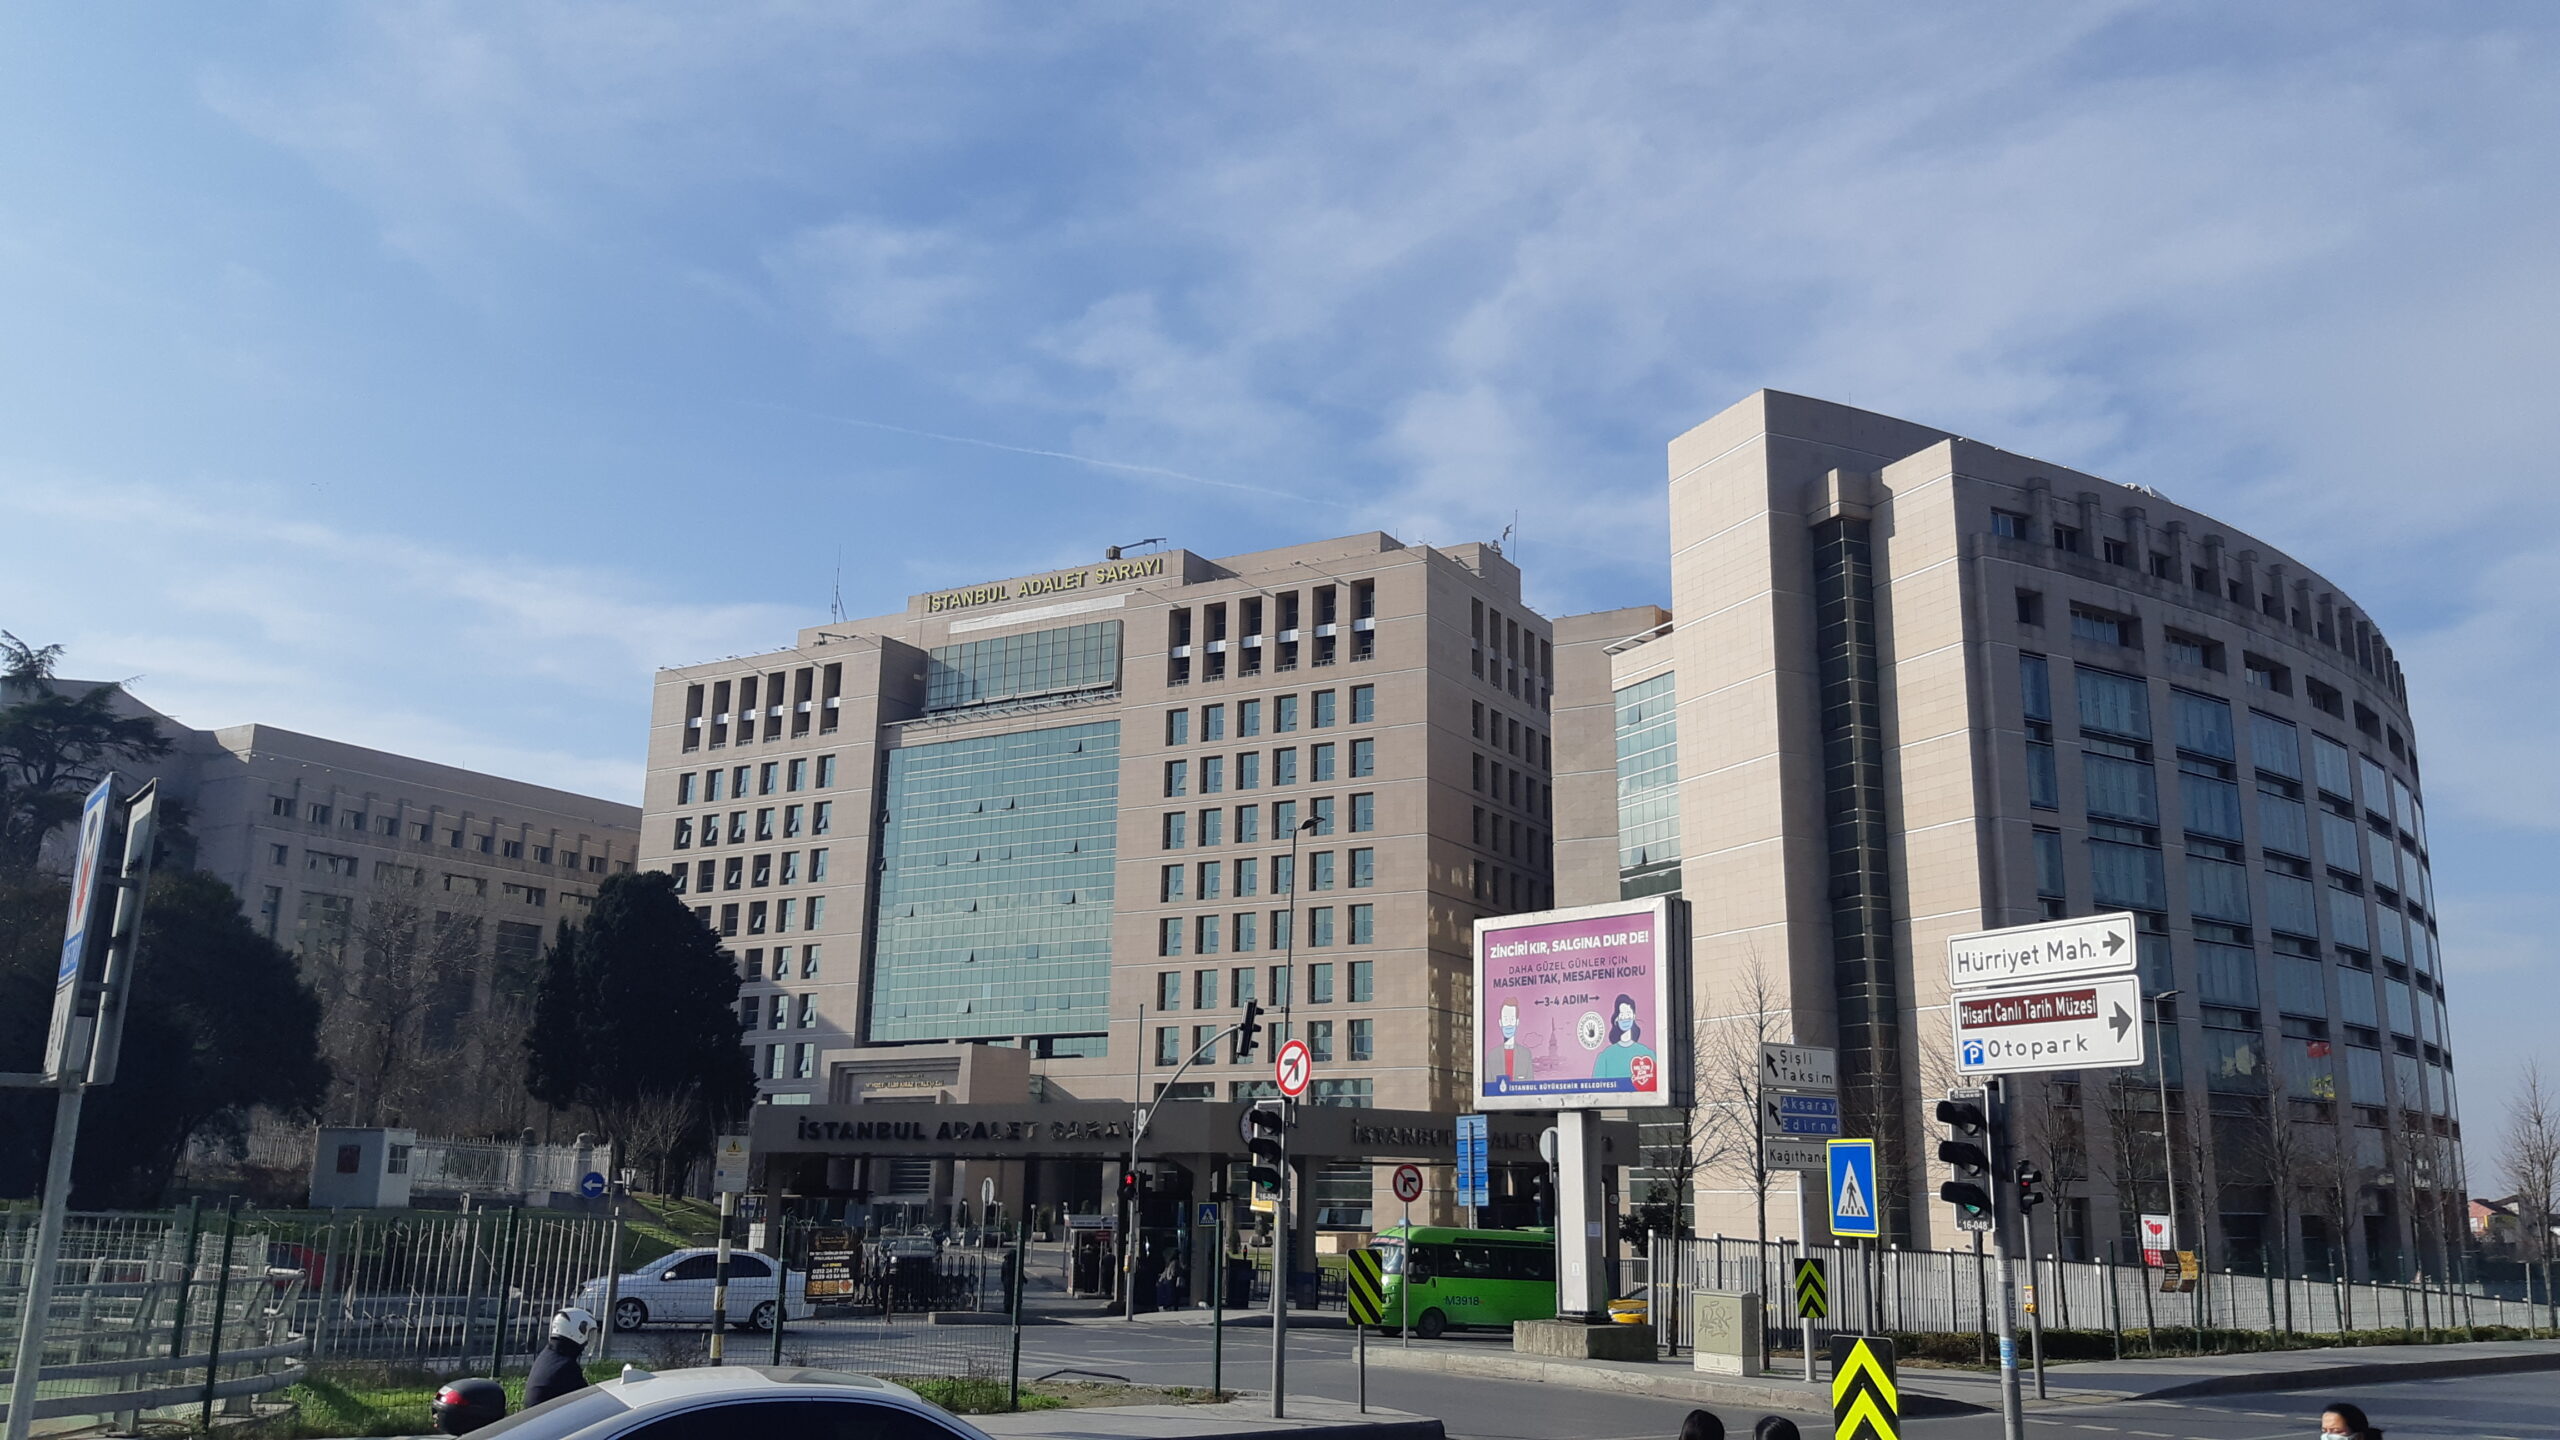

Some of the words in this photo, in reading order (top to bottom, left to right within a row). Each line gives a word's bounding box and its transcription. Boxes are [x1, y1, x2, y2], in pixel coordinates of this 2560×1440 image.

[927, 585, 1010, 613] İSTANBUL
[1017, 571, 1088, 599] ADALET
[1095, 557, 1163, 585] SARAYI
[1490, 940, 1528, 959] ZİNCİRİ
[1529, 940, 1550, 956] KIR,
[1552, 937, 1600, 952] SALGINA
[1603, 933, 1627, 947] DUR
[1629, 930, 1649, 945] DE!
[1957, 945, 2040, 973] Hürriyet
[2047, 937, 2097, 963] Mah.
[1508, 963, 1533, 975] DAHA
[1536, 960, 1566, 972] GÜZEL
[1568, 957, 1605, 970] GÜNLER
[1608, 955, 1628, 968] İÇİN
[1538, 971, 1561, 986] TAK,
[1562, 967, 1615, 983] MESAFENİ
[1616, 964, 1646, 979] KORU
[1544, 996, 1560, 1007] 3-4
[1562, 993, 1589, 1006] ADIM
[1960, 1004, 1993, 1026] Hisart
[1994, 1000, 2022, 1022] Canlı
[2023, 997, 2053, 1020] Tarih
[2055, 994, 2097, 1018] Müzesi
[1988, 1033, 2089, 1060] Otopark
[1780, 1049, 1812, 1066] Şişli
[1781, 1067, 1833, 1085] Taksim
[1782, 1097, 1836, 1113] Aksaray
[1782, 1118, 1837, 1132] Edirne
[1770, 1148, 1827, 1165] Kağıthane
[1962, 1220, 1988, 1231] 16-048
[1445, 1295, 1480, 1306] M3918
